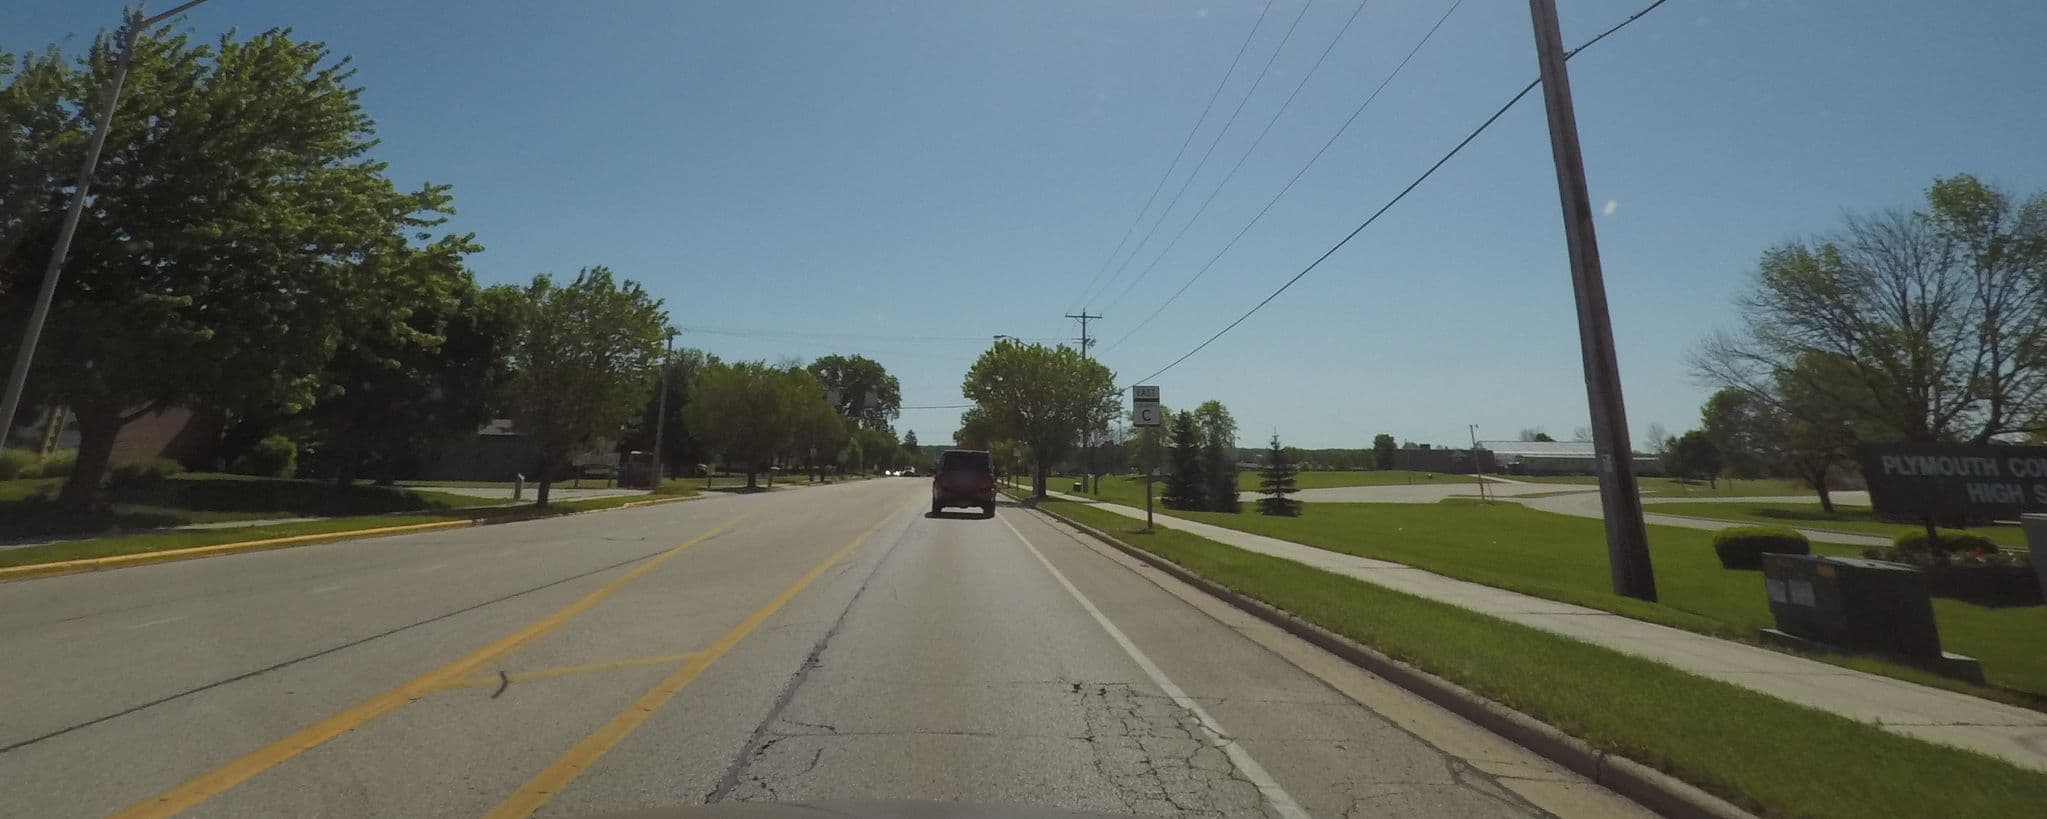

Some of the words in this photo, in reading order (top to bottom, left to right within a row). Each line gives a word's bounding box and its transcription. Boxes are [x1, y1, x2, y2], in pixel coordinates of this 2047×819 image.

[1142, 409, 1152, 421] C
[1881, 455, 2000, 476] PLYMOUTH
[1966, 482, 2025, 503] HIGH
